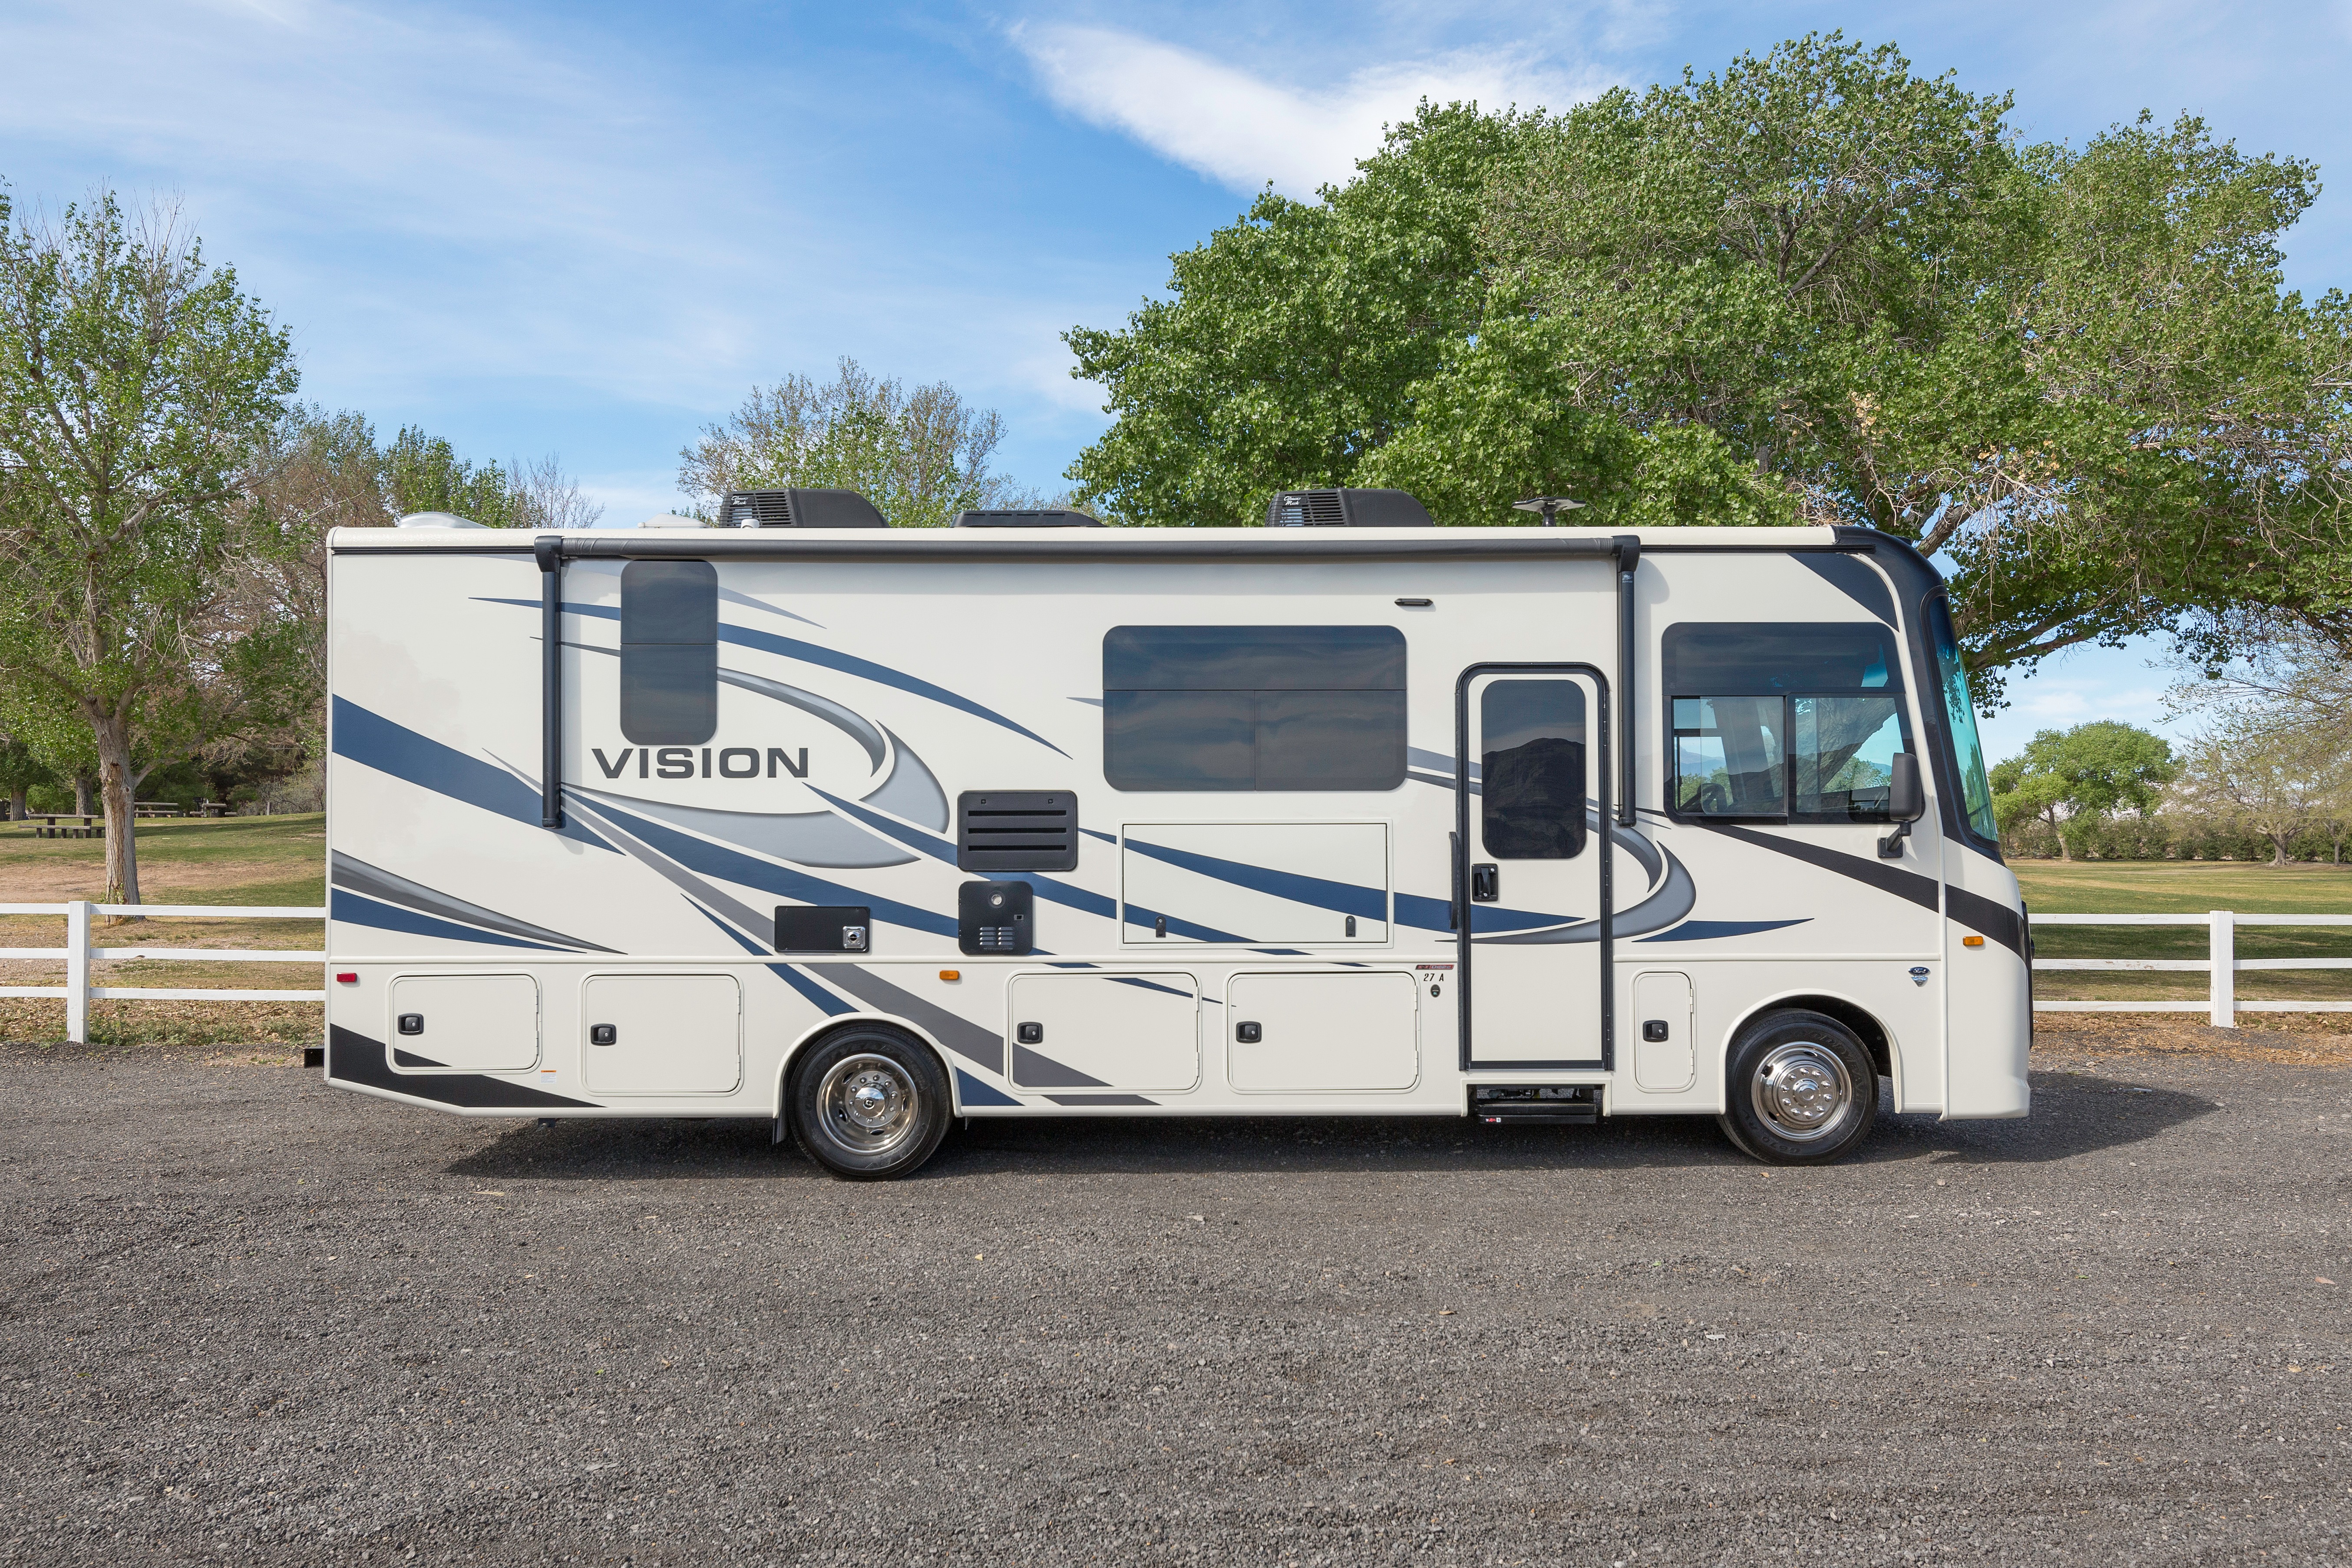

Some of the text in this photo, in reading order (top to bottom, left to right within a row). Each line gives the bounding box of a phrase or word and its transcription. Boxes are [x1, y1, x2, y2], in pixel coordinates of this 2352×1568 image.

[591, 748, 808, 779] VISION
[1424, 973, 1444, 981] 27 A
